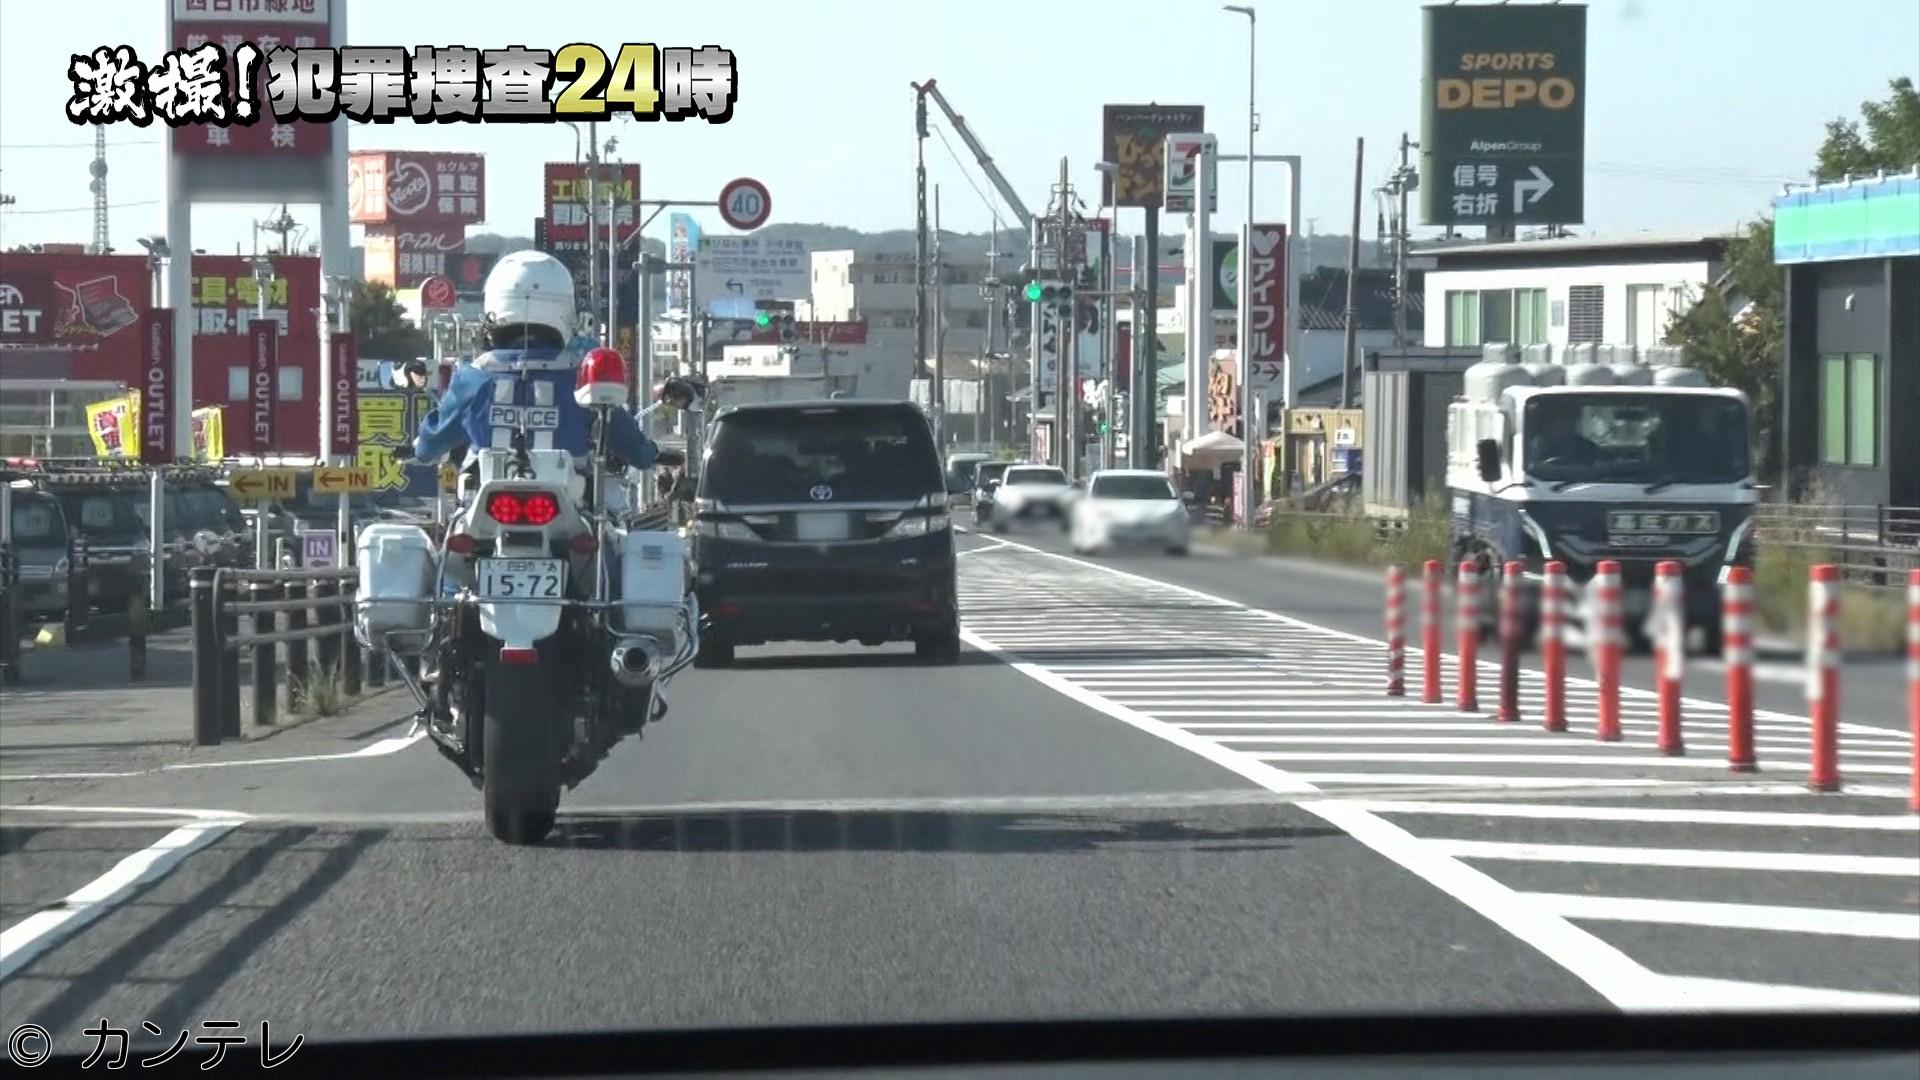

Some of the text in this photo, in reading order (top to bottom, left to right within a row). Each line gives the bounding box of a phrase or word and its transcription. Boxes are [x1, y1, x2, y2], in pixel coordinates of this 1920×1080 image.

[1460, 53, 1555, 71] SPORTS
[1437, 77, 1576, 110] DEPO
[1470, 140, 1541, 151] AlpenGroup
[1452, 164, 1499, 188] 信号
[731, 194, 760, 215] 40
[1452, 192, 1499, 217] 右折
[1252, 257, 1276, 356] アイフル
[148, 368, 165, 451] OUTLET
[255, 371, 270, 445] OUTLET
[337, 379, 350, 444] OUTLET
[491, 407, 557, 427] POLICE
[268, 475, 289, 492] IN
[348, 472, 368, 487] IN
[310, 540, 329, 556] IN
[487, 574, 558, 596] 15-72
